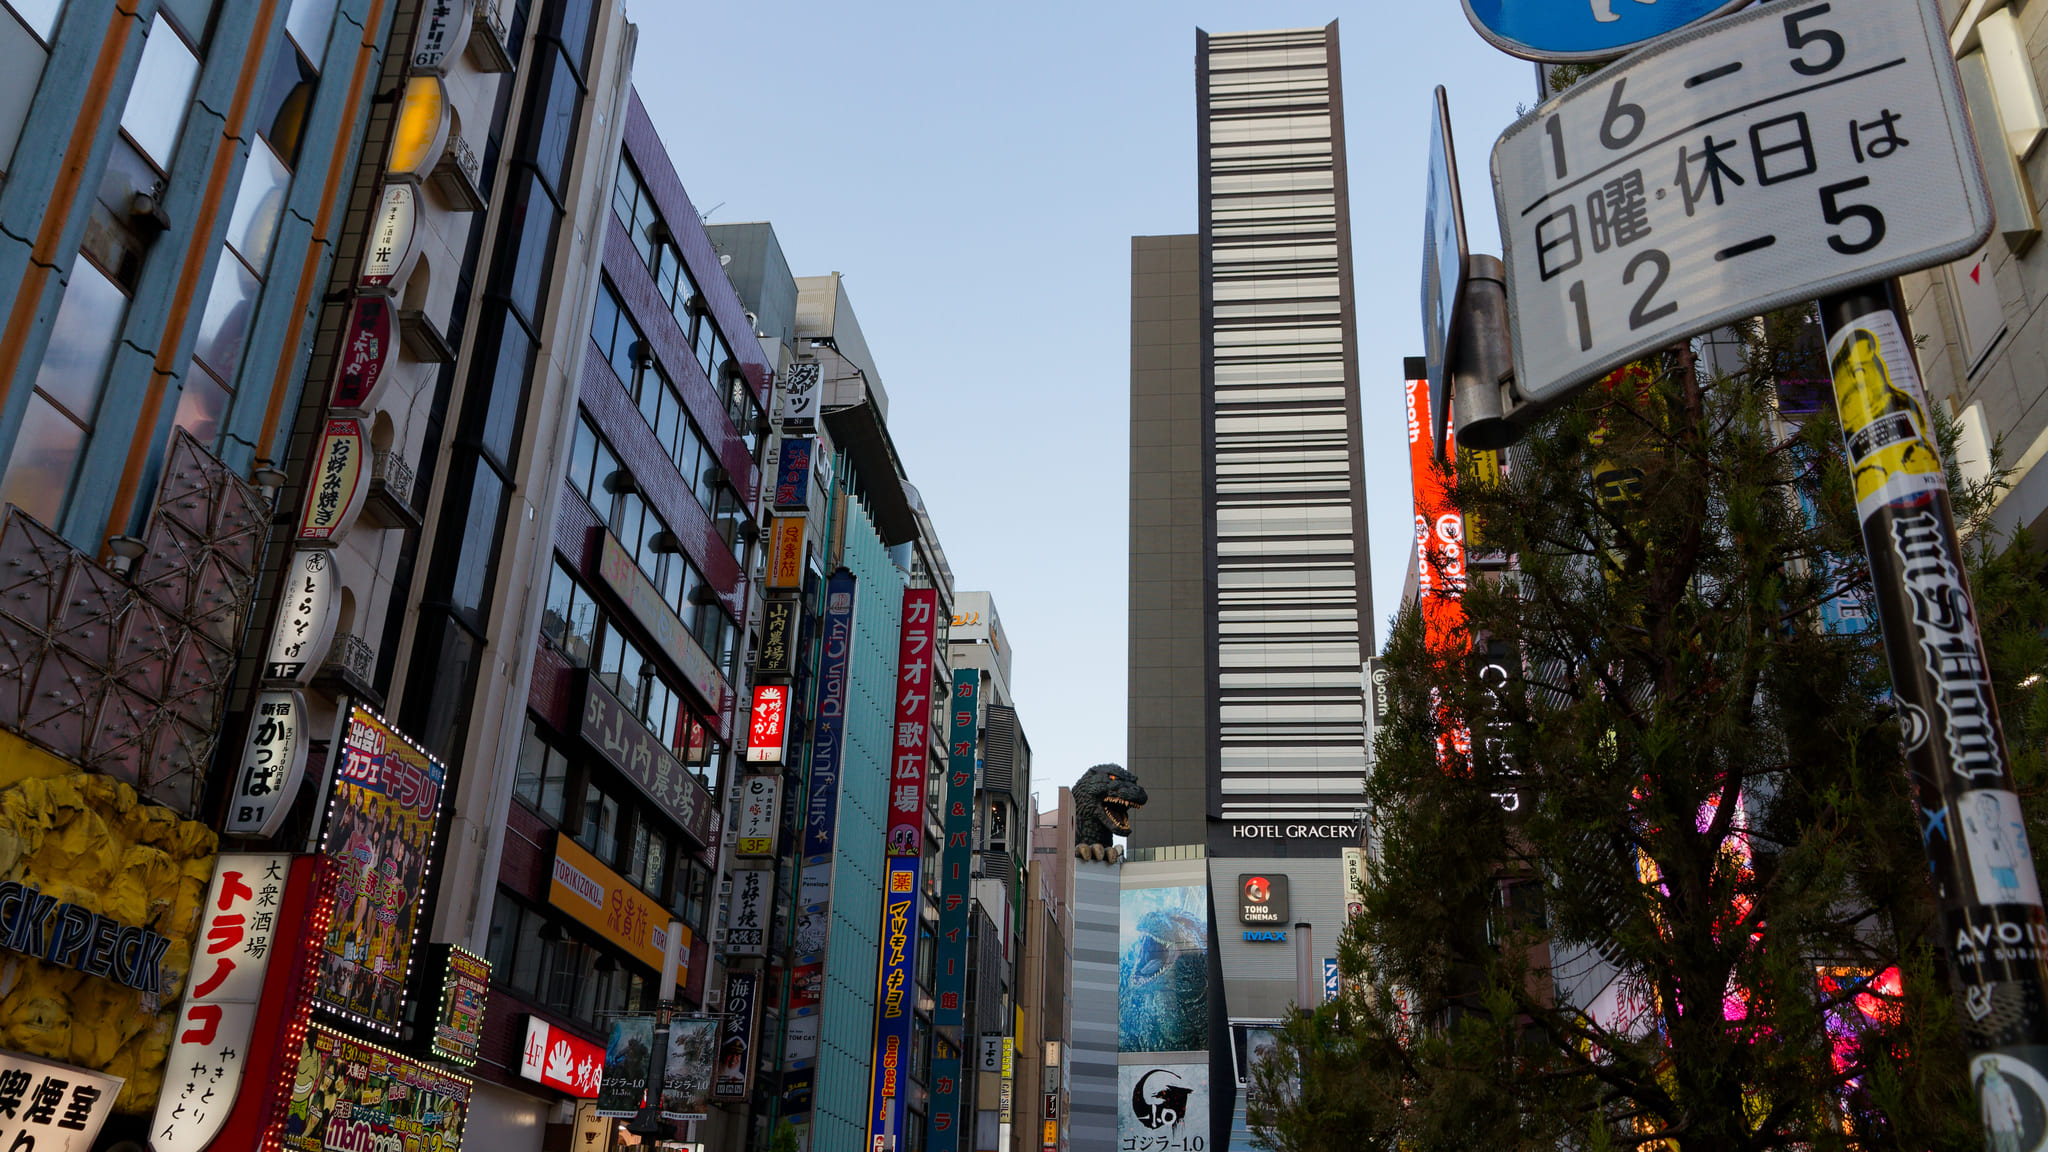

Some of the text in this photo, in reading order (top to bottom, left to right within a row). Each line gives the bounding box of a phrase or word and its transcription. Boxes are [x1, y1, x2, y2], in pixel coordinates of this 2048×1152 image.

[416, 53, 443, 65] 6F
[1536, 109, 1909, 281] 日曜・休日は
[376, 247, 391, 262] 光
[314, 438, 350, 526] お好み焼き
[777, 450, 808, 504] 海の家
[303, 528, 329, 538] 2階
[764, 604, 788, 661] 山内農場
[274, 664, 297, 678] 1F
[260, 703, 291, 717] 新宿
[754, 703, 768, 744] さかい
[768, 699, 783, 735] 焼肉屋
[894, 599, 930, 813] カラオケ歌広場
[242, 717, 285, 797] かっぱ
[350, 722, 386, 756] 出会い
[587, 692, 606, 729] 5F
[604, 709, 696, 827] 山内農場
[756, 749, 771, 761] 4F
[344, 753, 380, 784] カフェ
[381, 751, 438, 820] キラリ
[237, 806, 265, 823] B1
[1232, 825, 1358, 838] HOTEL GRACERY
[747, 840, 764, 851] 3F
[941, 683, 973, 1010] カラオケ&パーティー館
[555, 860, 601, 905] TORIKIZOKU
[892, 872, 911, 891] 薬
[244, 860, 282, 960] 大衆酒場
[1245, 906, 1269, 914] TOHO
[1245, 913, 1278, 921] CINEMAS
[56, 904, 171, 994] PECK
[729, 930, 761, 944] 大阪家
[1243, 931, 1287, 942] IMAX
[181, 871, 253, 1046] トラノコ
[884, 900, 911, 1019] マツモトキヨシ
[727, 979, 750, 1032] 海の家
[525, 1032, 543, 1067] 4F
[884, 1035, 899, 1068] Shop
[194, 1046, 236, 1124] やきとり
[574, 1054, 603, 1095] 焼肉
[882, 1069, 896, 1096] Free
[0, 1068, 102, 1132] 喫煙室
[160, 1062, 207, 1141] やきとん
[934, 1076, 953, 1152] カラ
[1123, 1136, 1204, 1152] ゴジラ-1.0
